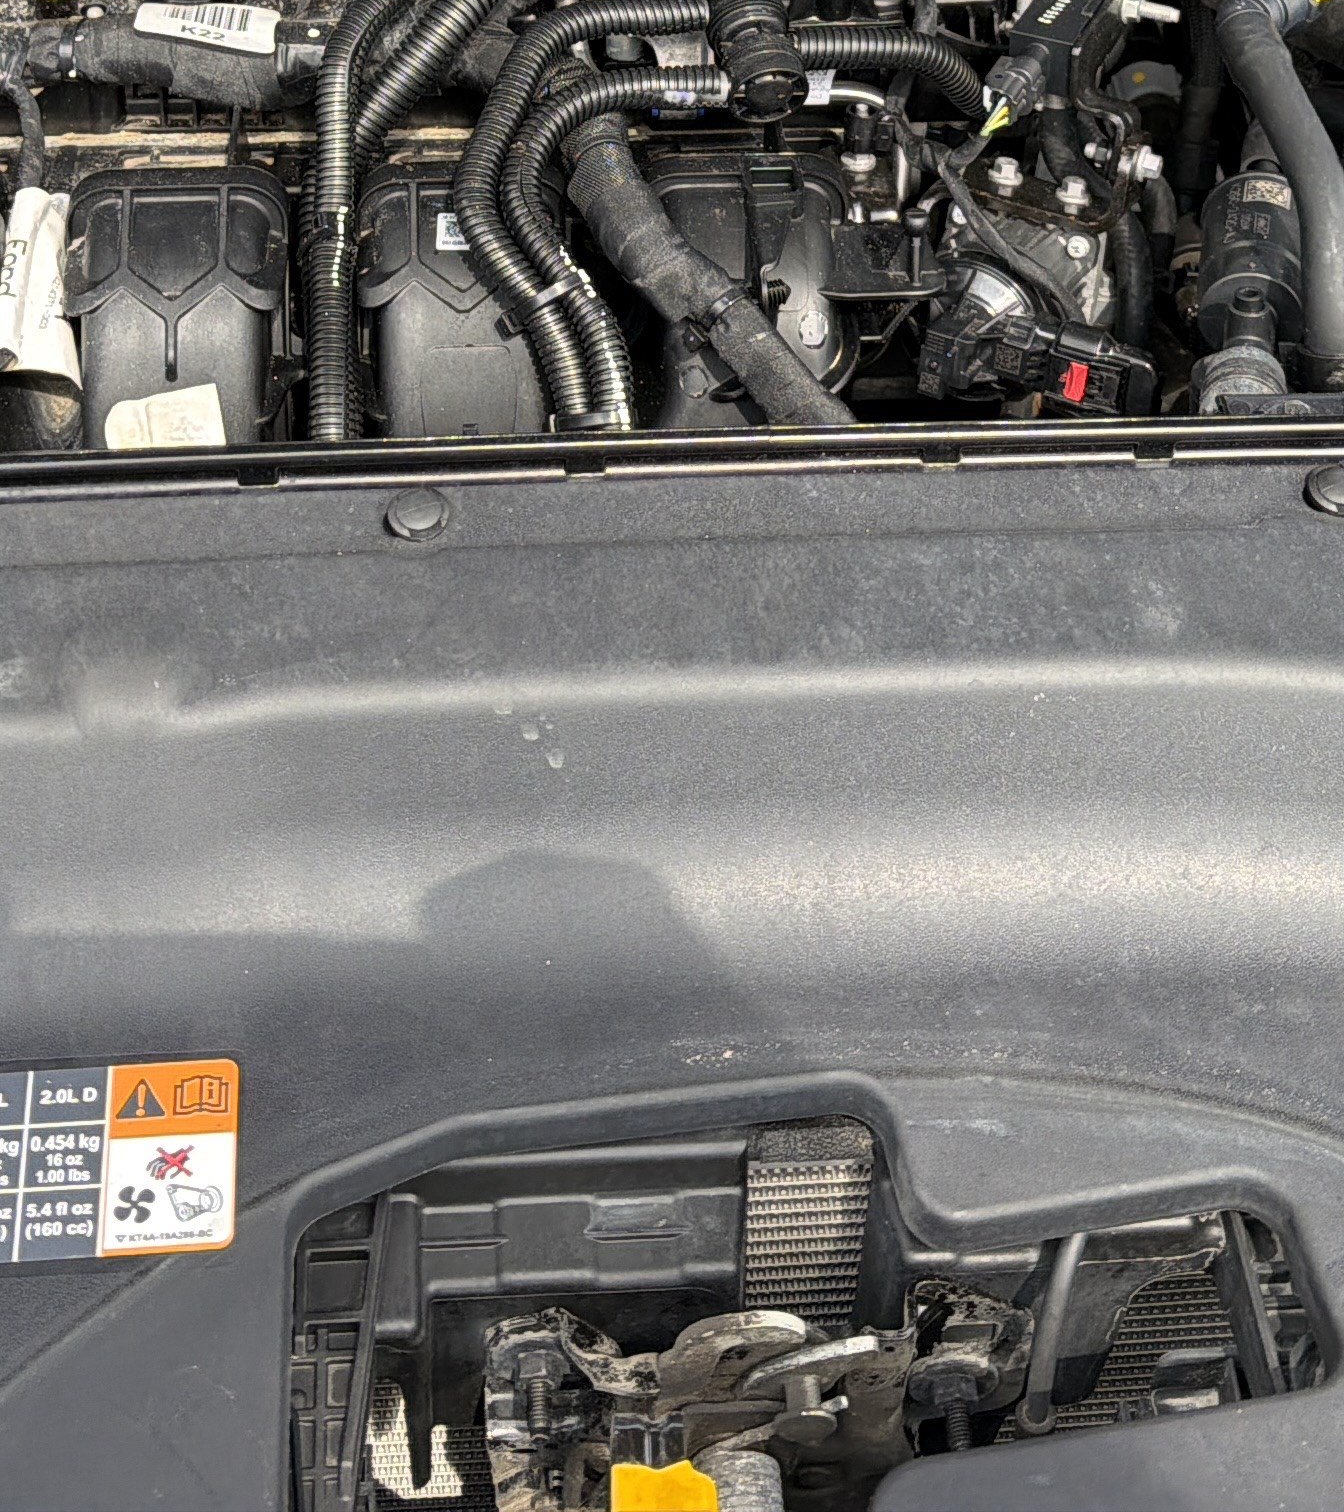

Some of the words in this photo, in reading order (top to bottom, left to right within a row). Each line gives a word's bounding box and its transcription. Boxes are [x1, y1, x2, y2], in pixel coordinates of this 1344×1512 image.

[39, 1088, 79, 1105] 2.0L
[82, 1087, 97, 1102] D
[30, 1134, 75, 1152] 0.454
[79, 1133, 100, 1152] kg
[46, 1153, 62, 1167] 16
[65, 1154, 83, 1166] oz
[35, 1169, 65, 1183] 1.00
[68, 1168, 90, 1182] lbs
[26, 1202, 52, 1218] 5.4
[55, 1202, 67, 1216] fl
[71, 1203, 93, 1216] oz
[25, 1222, 62, 1240] (160
[66, 1220, 93, 1237] cc)
